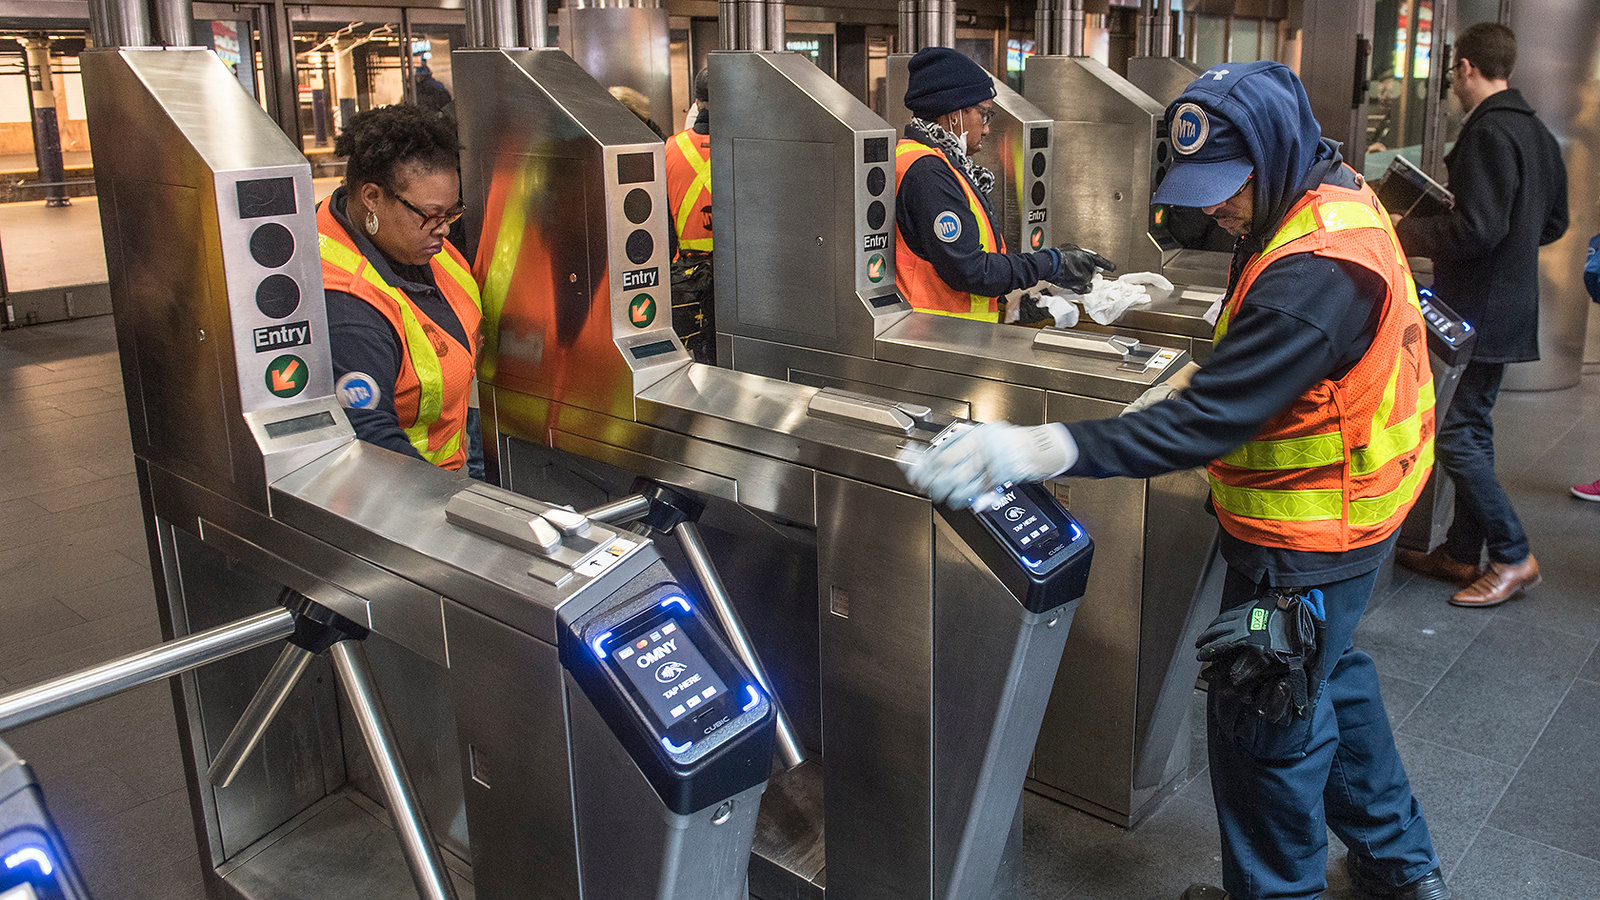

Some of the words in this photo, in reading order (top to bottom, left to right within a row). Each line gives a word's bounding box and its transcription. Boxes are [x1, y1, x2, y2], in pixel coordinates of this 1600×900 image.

[1176, 118, 1196, 139] MTA
[1028, 210, 1046, 222] Entry
[939, 220, 957, 236] MTA
[864, 234, 888, 248] Entry
[623, 270, 657, 287] Entry
[254, 325, 308, 347] Entry
[1012, 523, 1024, 533] TAP
[1022, 515, 1037, 527] HERE
[1048, 543, 1065, 556] CUBIC
[636, 637, 678, 669] OMNY
[662, 685, 680, 700] TAP
[677, 672, 702, 692] HERE
[703, 715, 731, 735] CUBIC
